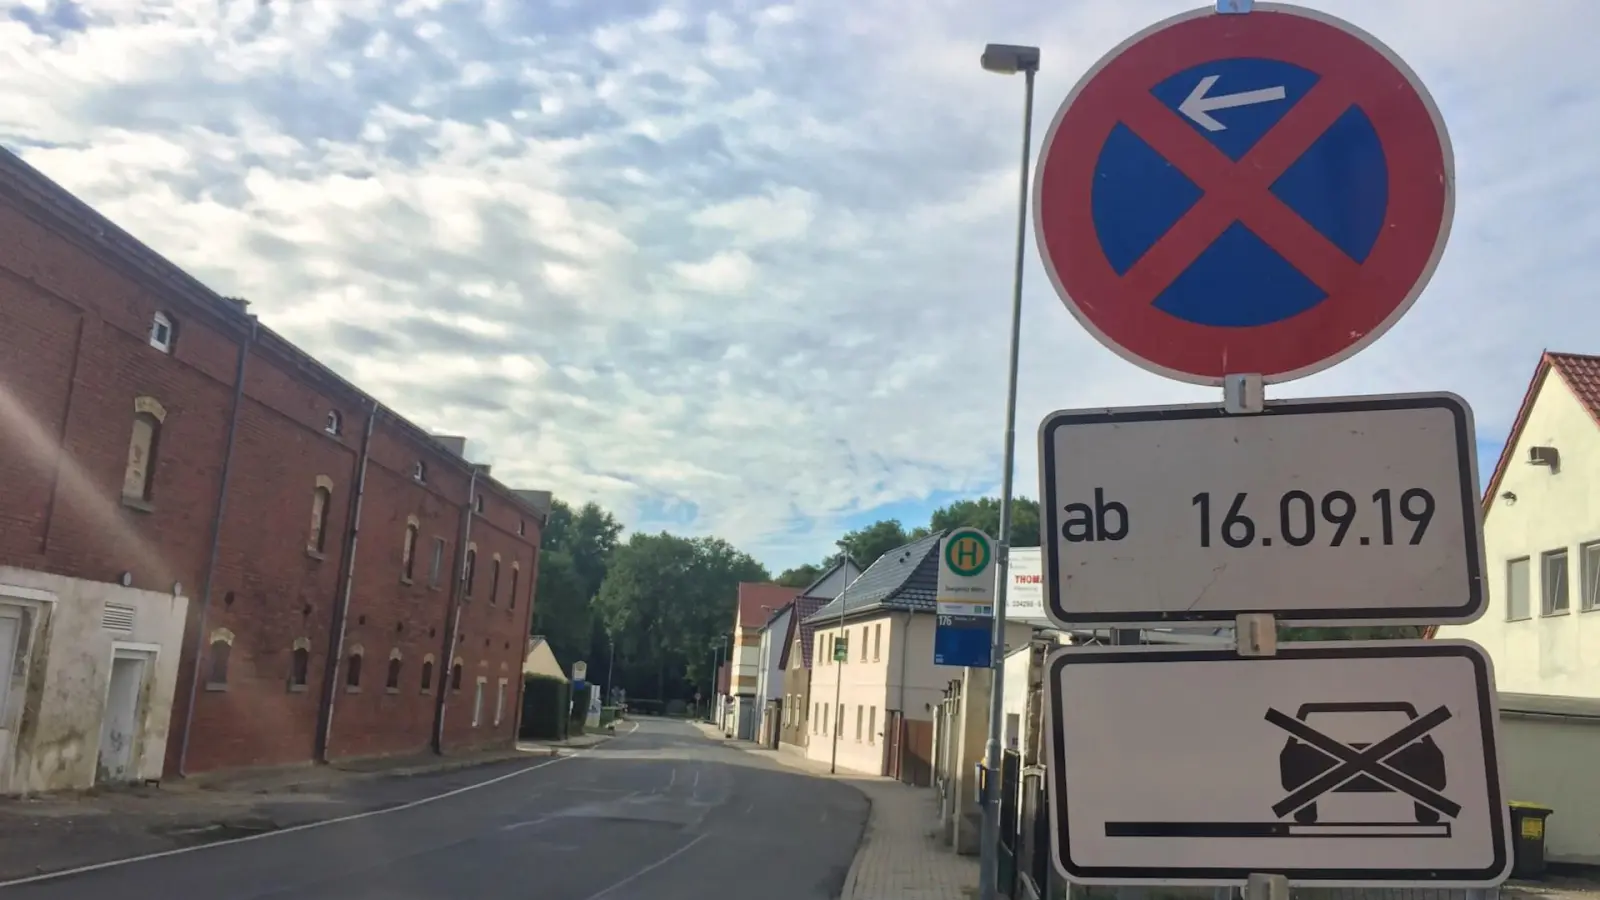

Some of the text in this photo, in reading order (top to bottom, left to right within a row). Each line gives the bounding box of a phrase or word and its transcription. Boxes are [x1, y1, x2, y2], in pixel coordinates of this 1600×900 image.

[1061, 487, 1436, 548] ab 16.09.19
[958, 540, 977, 567] H
[939, 615, 953, 626] 176
